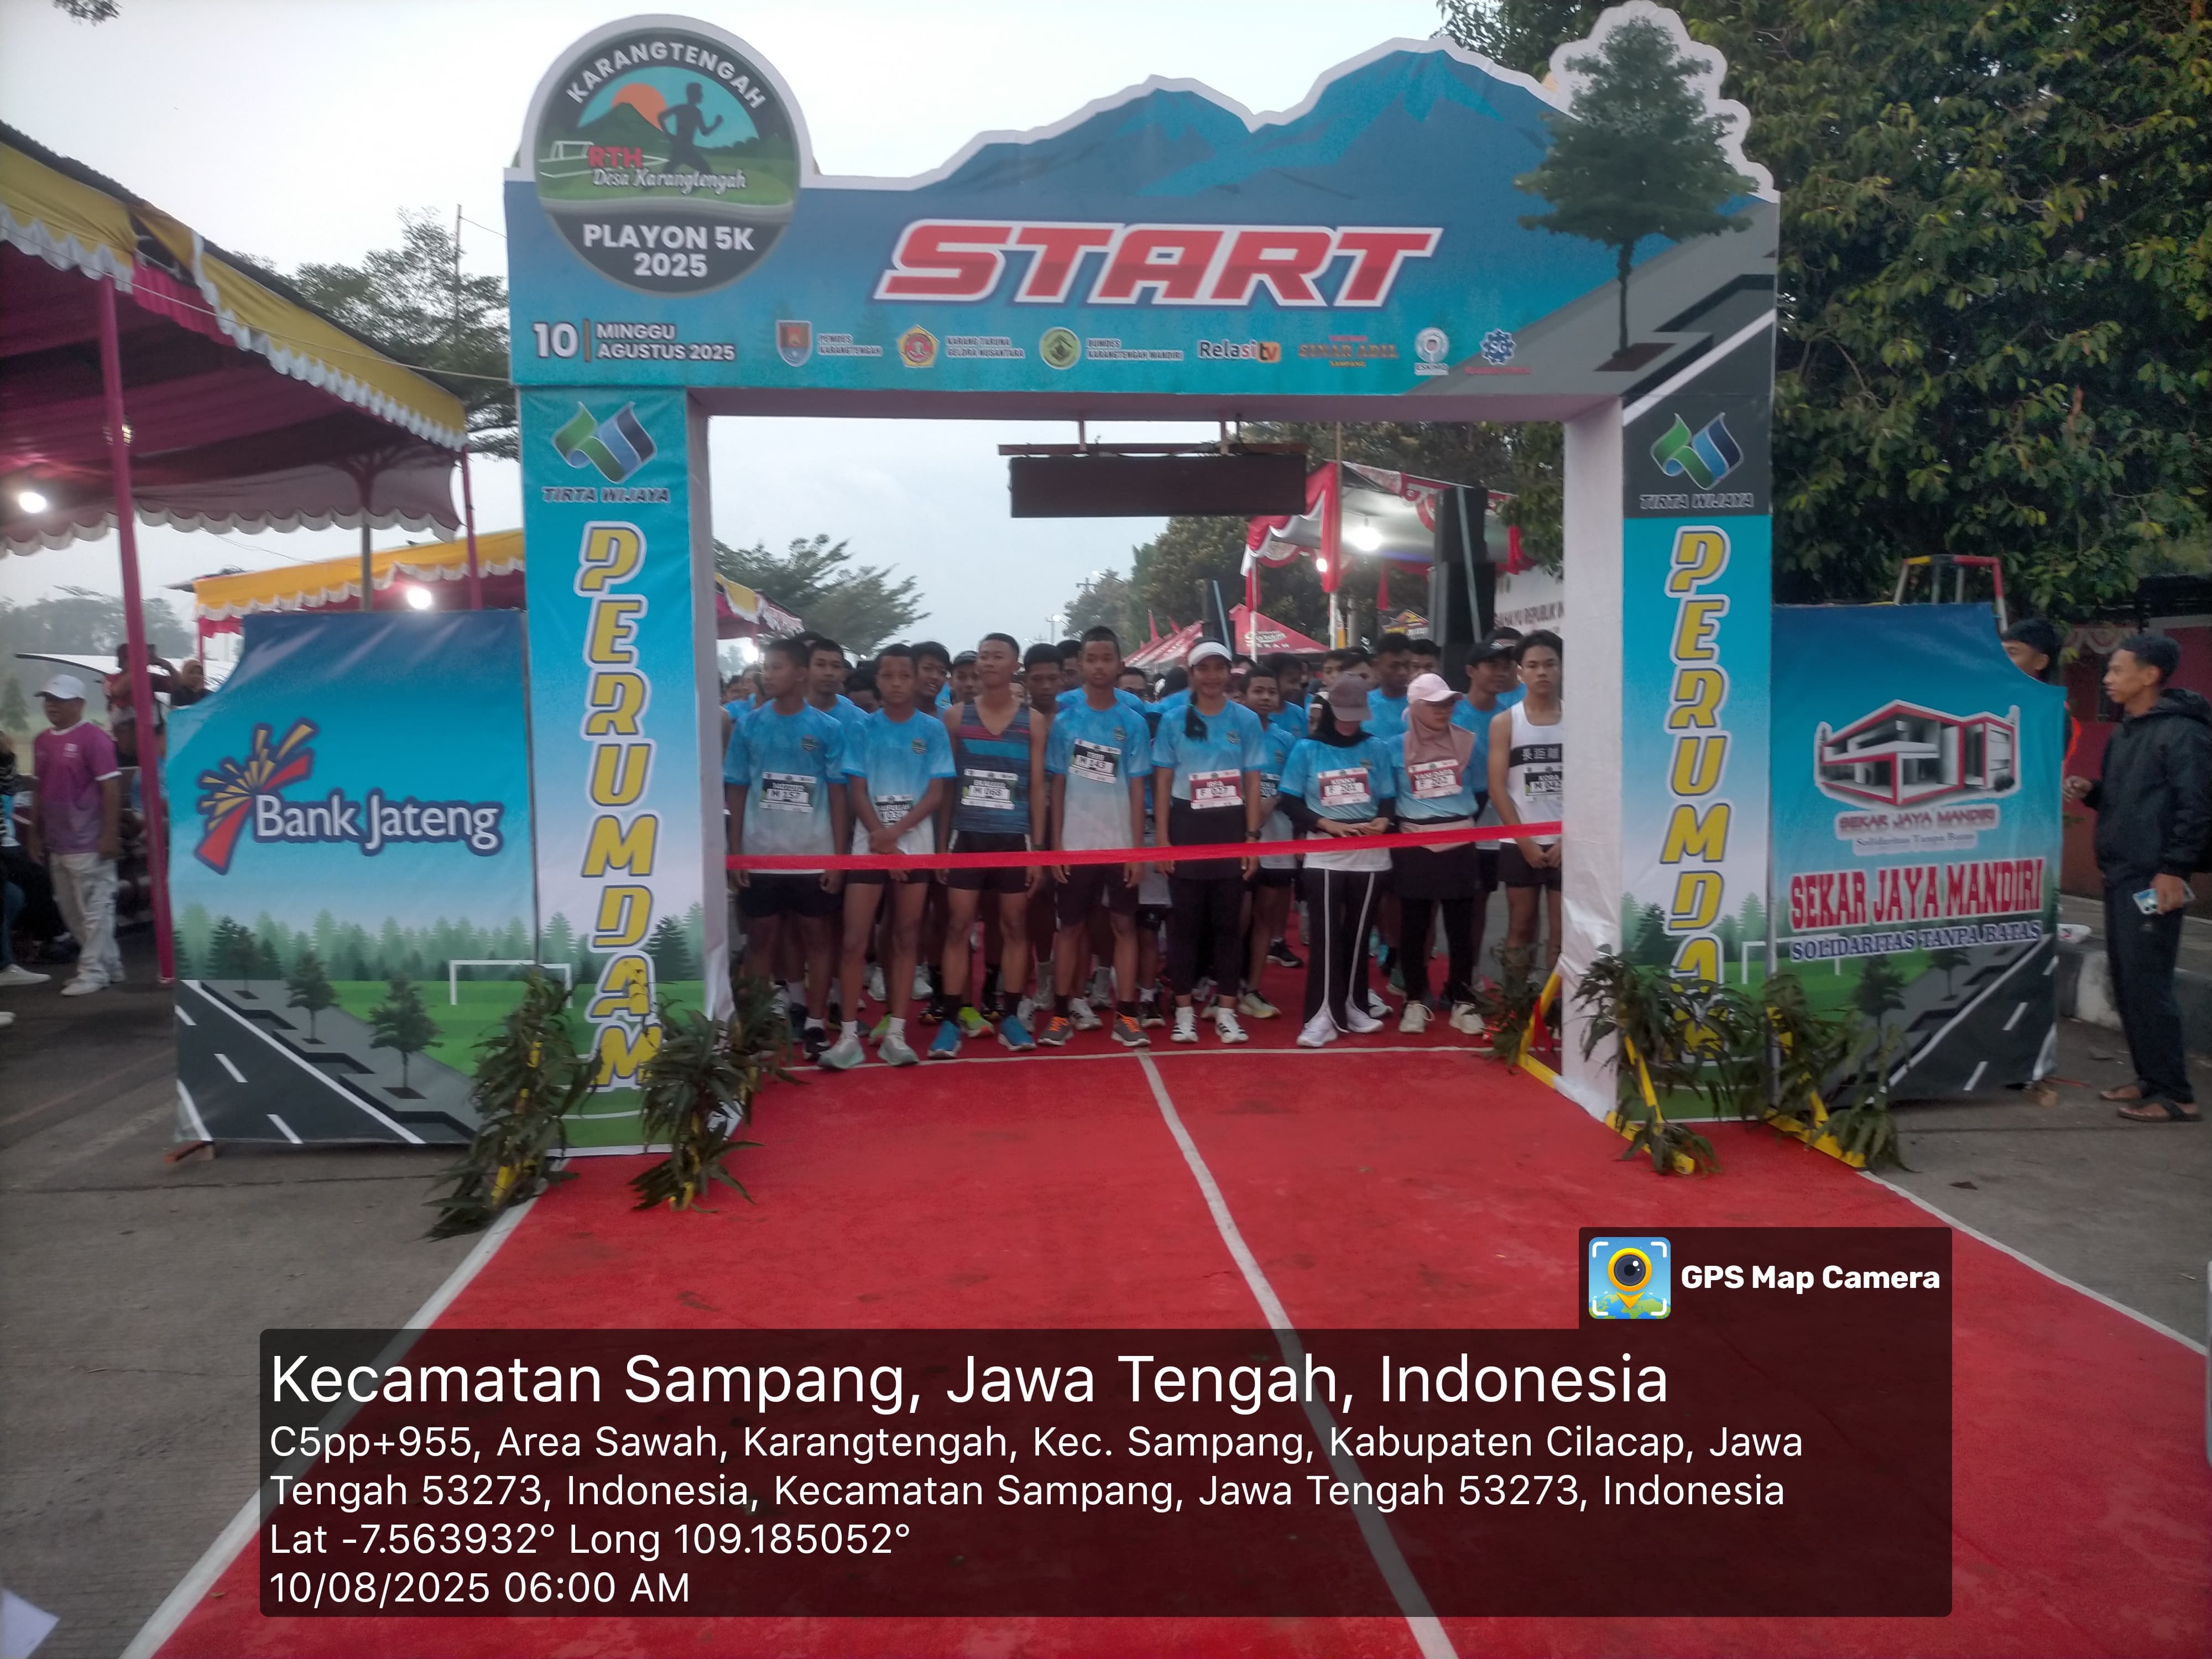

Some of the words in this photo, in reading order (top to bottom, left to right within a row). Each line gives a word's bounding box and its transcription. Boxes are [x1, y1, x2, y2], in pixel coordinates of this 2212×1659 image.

[565, 41, 766, 109] KARANGTENGAH
[588, 147, 643, 169] RTH
[592, 168, 629, 187] Desa
[633, 168, 747, 195] Karangtengah
[583, 224, 708, 250] PLAYON
[714, 226, 755, 252] 5K
[634, 253, 708, 278] 2025
[875, 218, 1442, 306] START
[533, 322, 579, 358] 10
[596, 323, 676, 340] MINGGU
[596, 343, 686, 361] AGUSTUS
[689, 344, 735, 361] 2025
[820, 346, 881, 354] KARANGTENGAH
[1300, 344, 1352, 358] SINAR
[1357, 344, 1399, 359] ADIL
[542, 487, 598, 503] TIRTA
[601, 487, 671, 504] WIJAYA
[1640, 494, 1689, 509] TIRTA
[1692, 493, 1754, 509] WIJAYA
[574, 521, 664, 1089] PERUMDAM
[255, 794, 359, 837] Bank
[364, 794, 500, 851] Jateng
[1839, 815, 1888, 829] SEKAR
[1892, 812, 1933, 826] JAYA
[1937, 808, 1996, 823] MANDIRI
[1790, 871, 1867, 930] SEKAR
[1873, 865, 1939, 922] JAYA
[1945, 859, 2044, 917] MANDIRI
[1792, 931, 1916, 961] SOLIDARITAS
[1921, 925, 1979, 949] TANPA
[1982, 922, 2042, 946] BATAS
